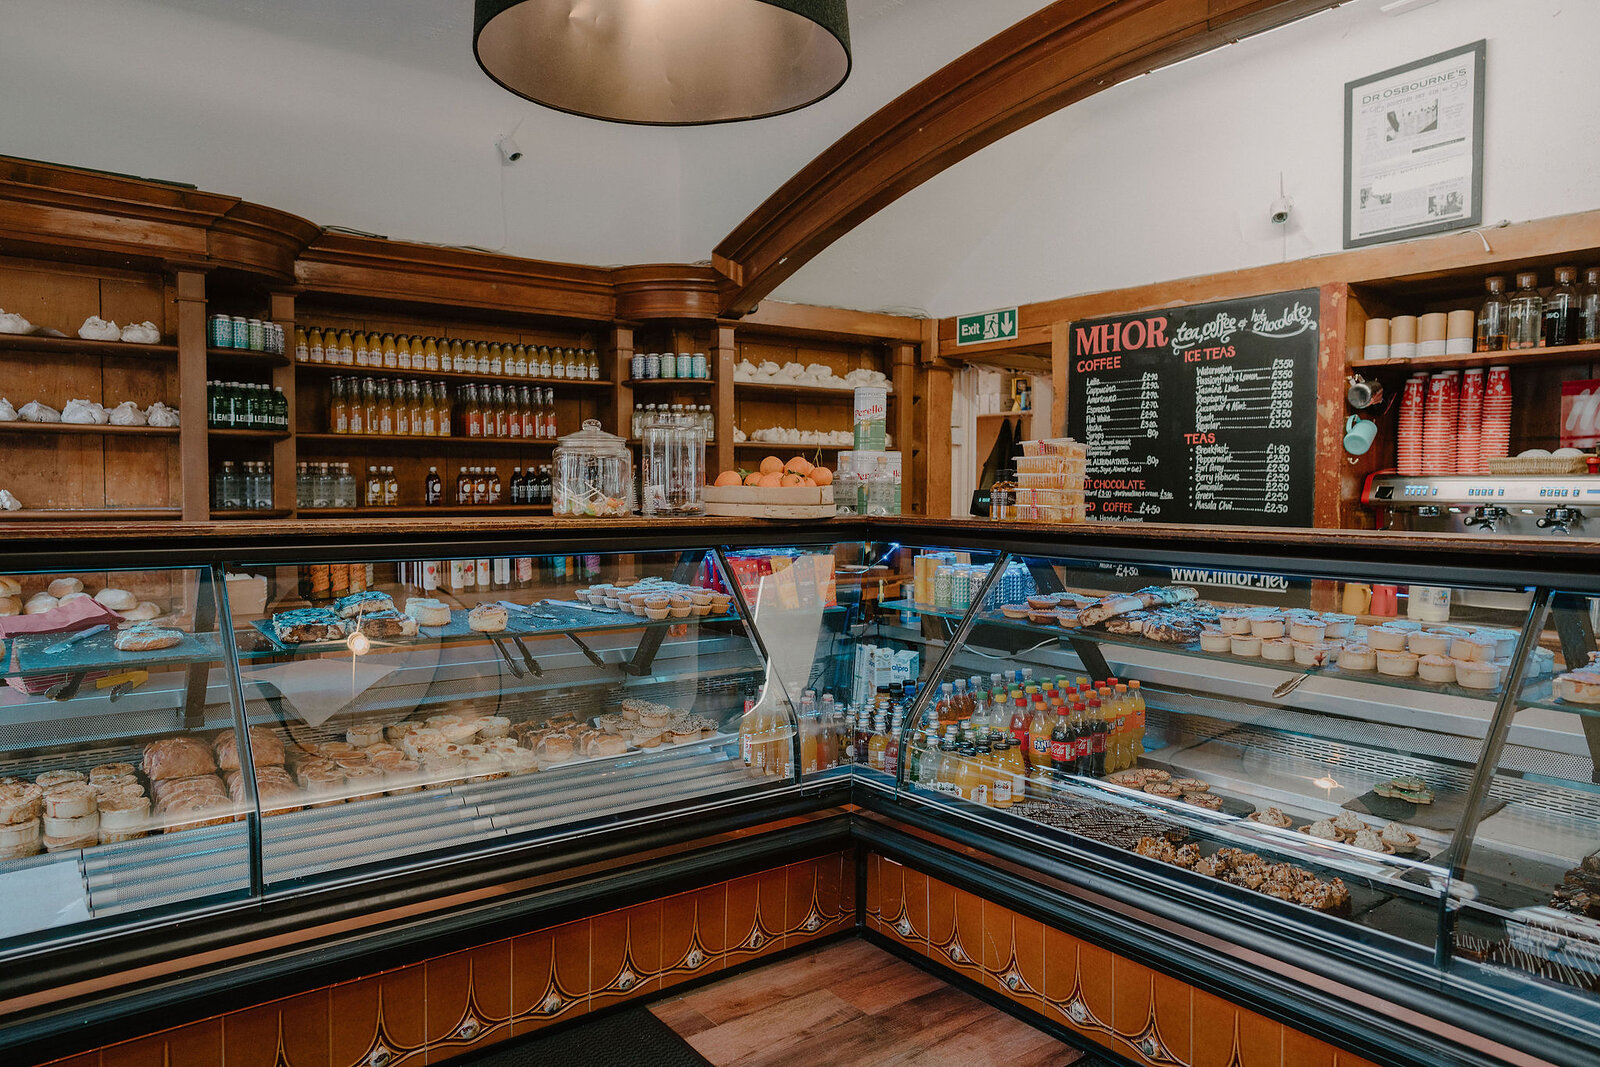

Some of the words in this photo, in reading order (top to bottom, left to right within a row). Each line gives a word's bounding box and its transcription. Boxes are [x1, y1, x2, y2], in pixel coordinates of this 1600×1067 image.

[1363, 94, 1380, 104] DR
[1383, 68, 1467, 98] OSBOURNE'S
[961, 323, 980, 336] Exit
[1202, 312, 1237, 342] coffee
[1251, 308, 1267, 322] hot
[1075, 316, 1169, 356] MHOR
[1184, 349, 1202, 363] ICE
[1203, 345, 1236, 360] TEAS
[1077, 355, 1122, 373] COFFEE
[1196, 365, 1233, 376] Watermelon
[1240, 372, 1258, 381] Lemon
[1224, 384, 1240, 392] Lime
[1196, 403, 1225, 414] Cucumber
[1231, 401, 1247, 411] Mint
[1086, 415, 1096, 424] Flat
[1196, 412, 1214, 423] Peach
[1196, 421, 1220, 433] Regular
[1147, 428, 1159, 439] 80p
[1184, 433, 1216, 445] TEAS
[1195, 443, 1229, 455] Breakfast
[1146, 455, 1159, 467] 80p
[1195, 453, 1233, 465] Peppermint
[1195, 463, 1208, 473] Earl
[1209, 463, 1224, 474] Grey
[1195, 472, 1214, 484] Berry
[1214, 473, 1240, 482] Hibiscus
[1083, 480, 1093, 490] OT
[1094, 480, 1146, 490] CHOCOLATE
[1195, 482, 1224, 491] Camomile
[1195, 491, 1214, 500] Green
[1103, 502, 1133, 513] COFFEE
[1195, 500, 1217, 511] Masala
[1218, 500, 1233, 510] Chai
[891, 663, 908, 673] alpro
